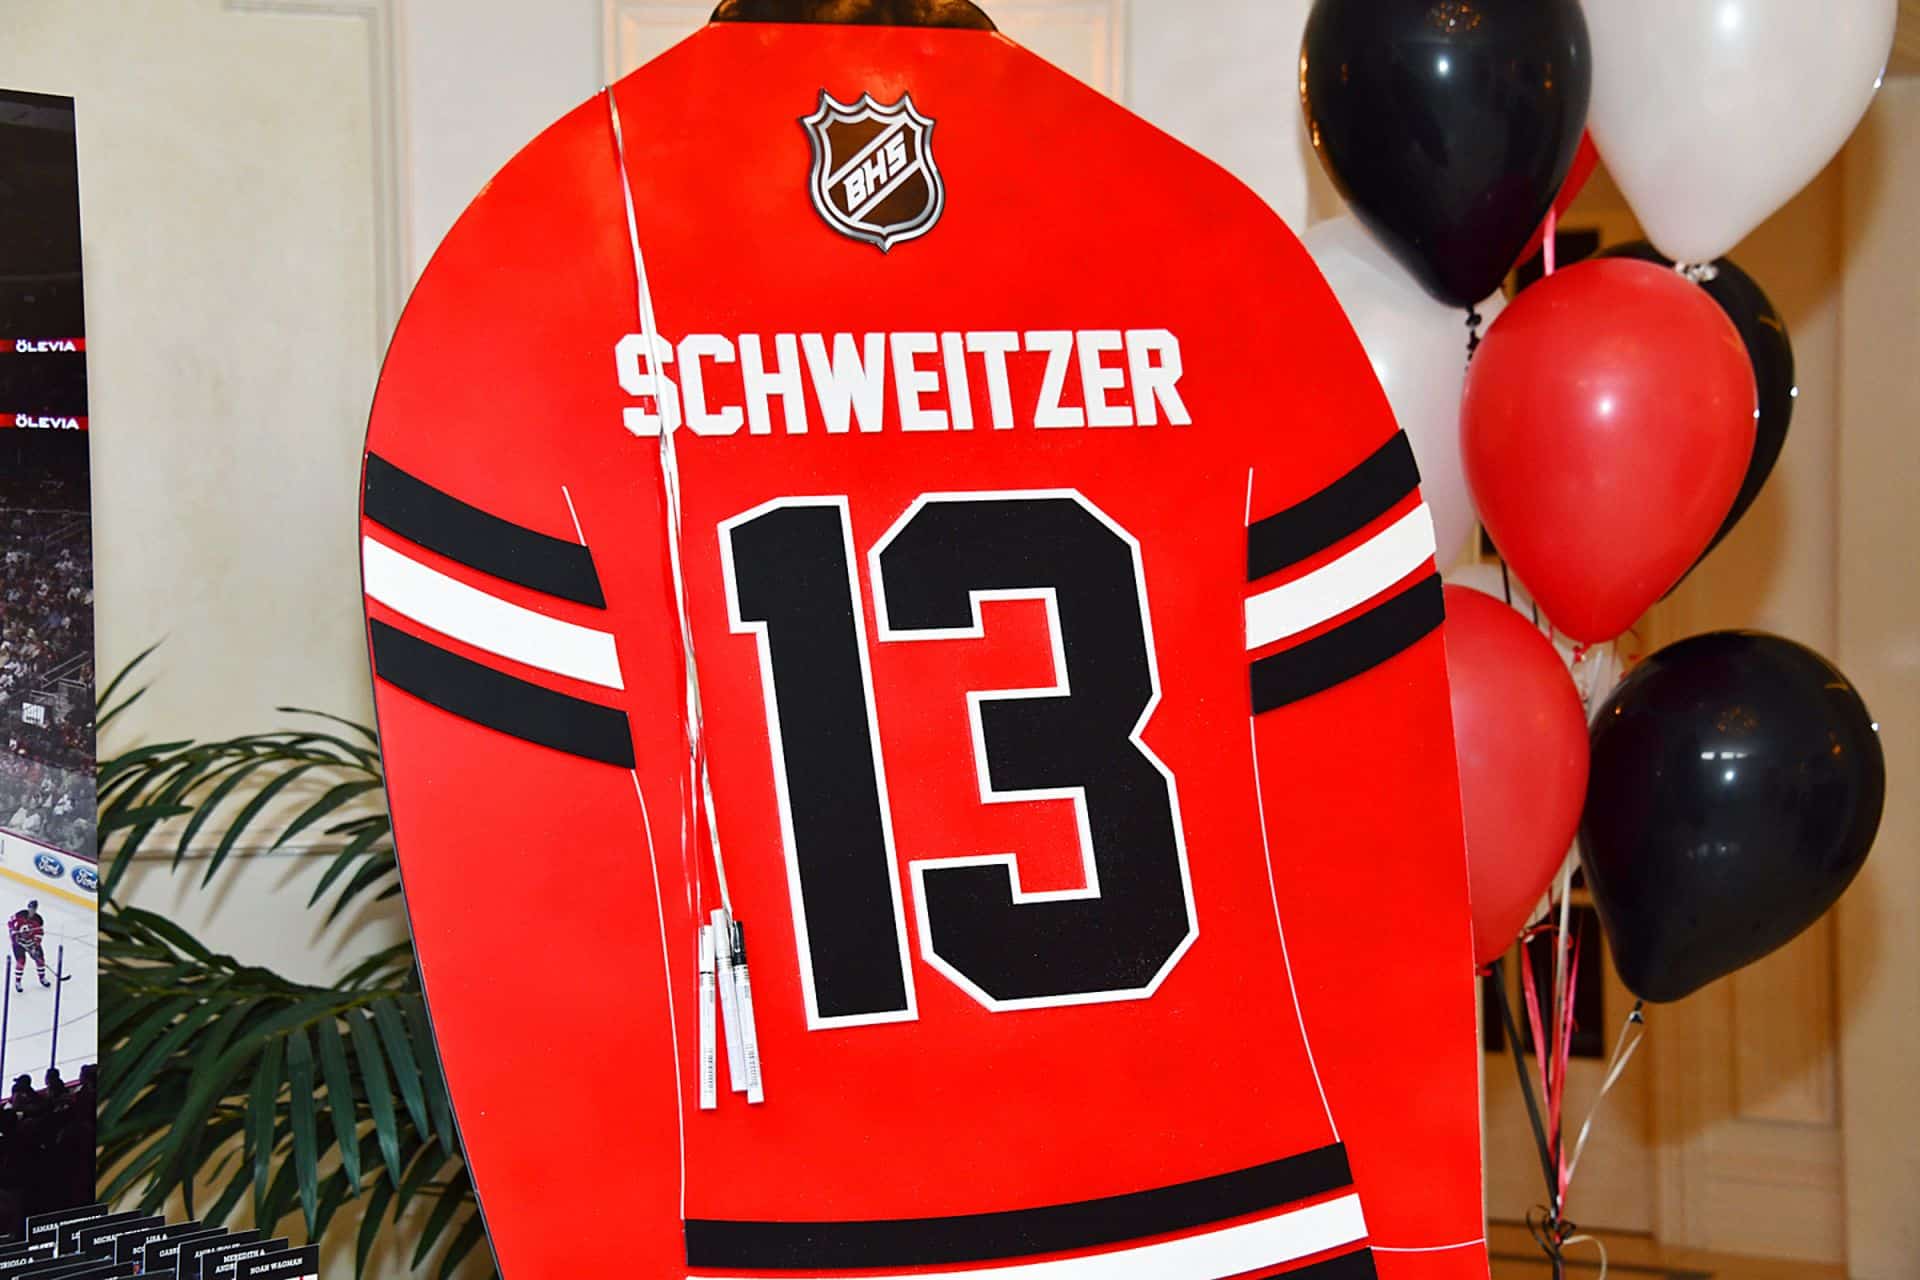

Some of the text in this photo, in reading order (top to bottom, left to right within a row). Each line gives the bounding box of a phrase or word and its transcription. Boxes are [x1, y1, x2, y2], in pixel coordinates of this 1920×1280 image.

[844, 131, 907, 212] BHS
[16, 339, 76, 353] ÖLEVIA
[614, 328, 1193, 438] SCHWEITZER
[16, 413, 80, 430] ÖLEVIA
[717, 488, 1200, 1031] 13
